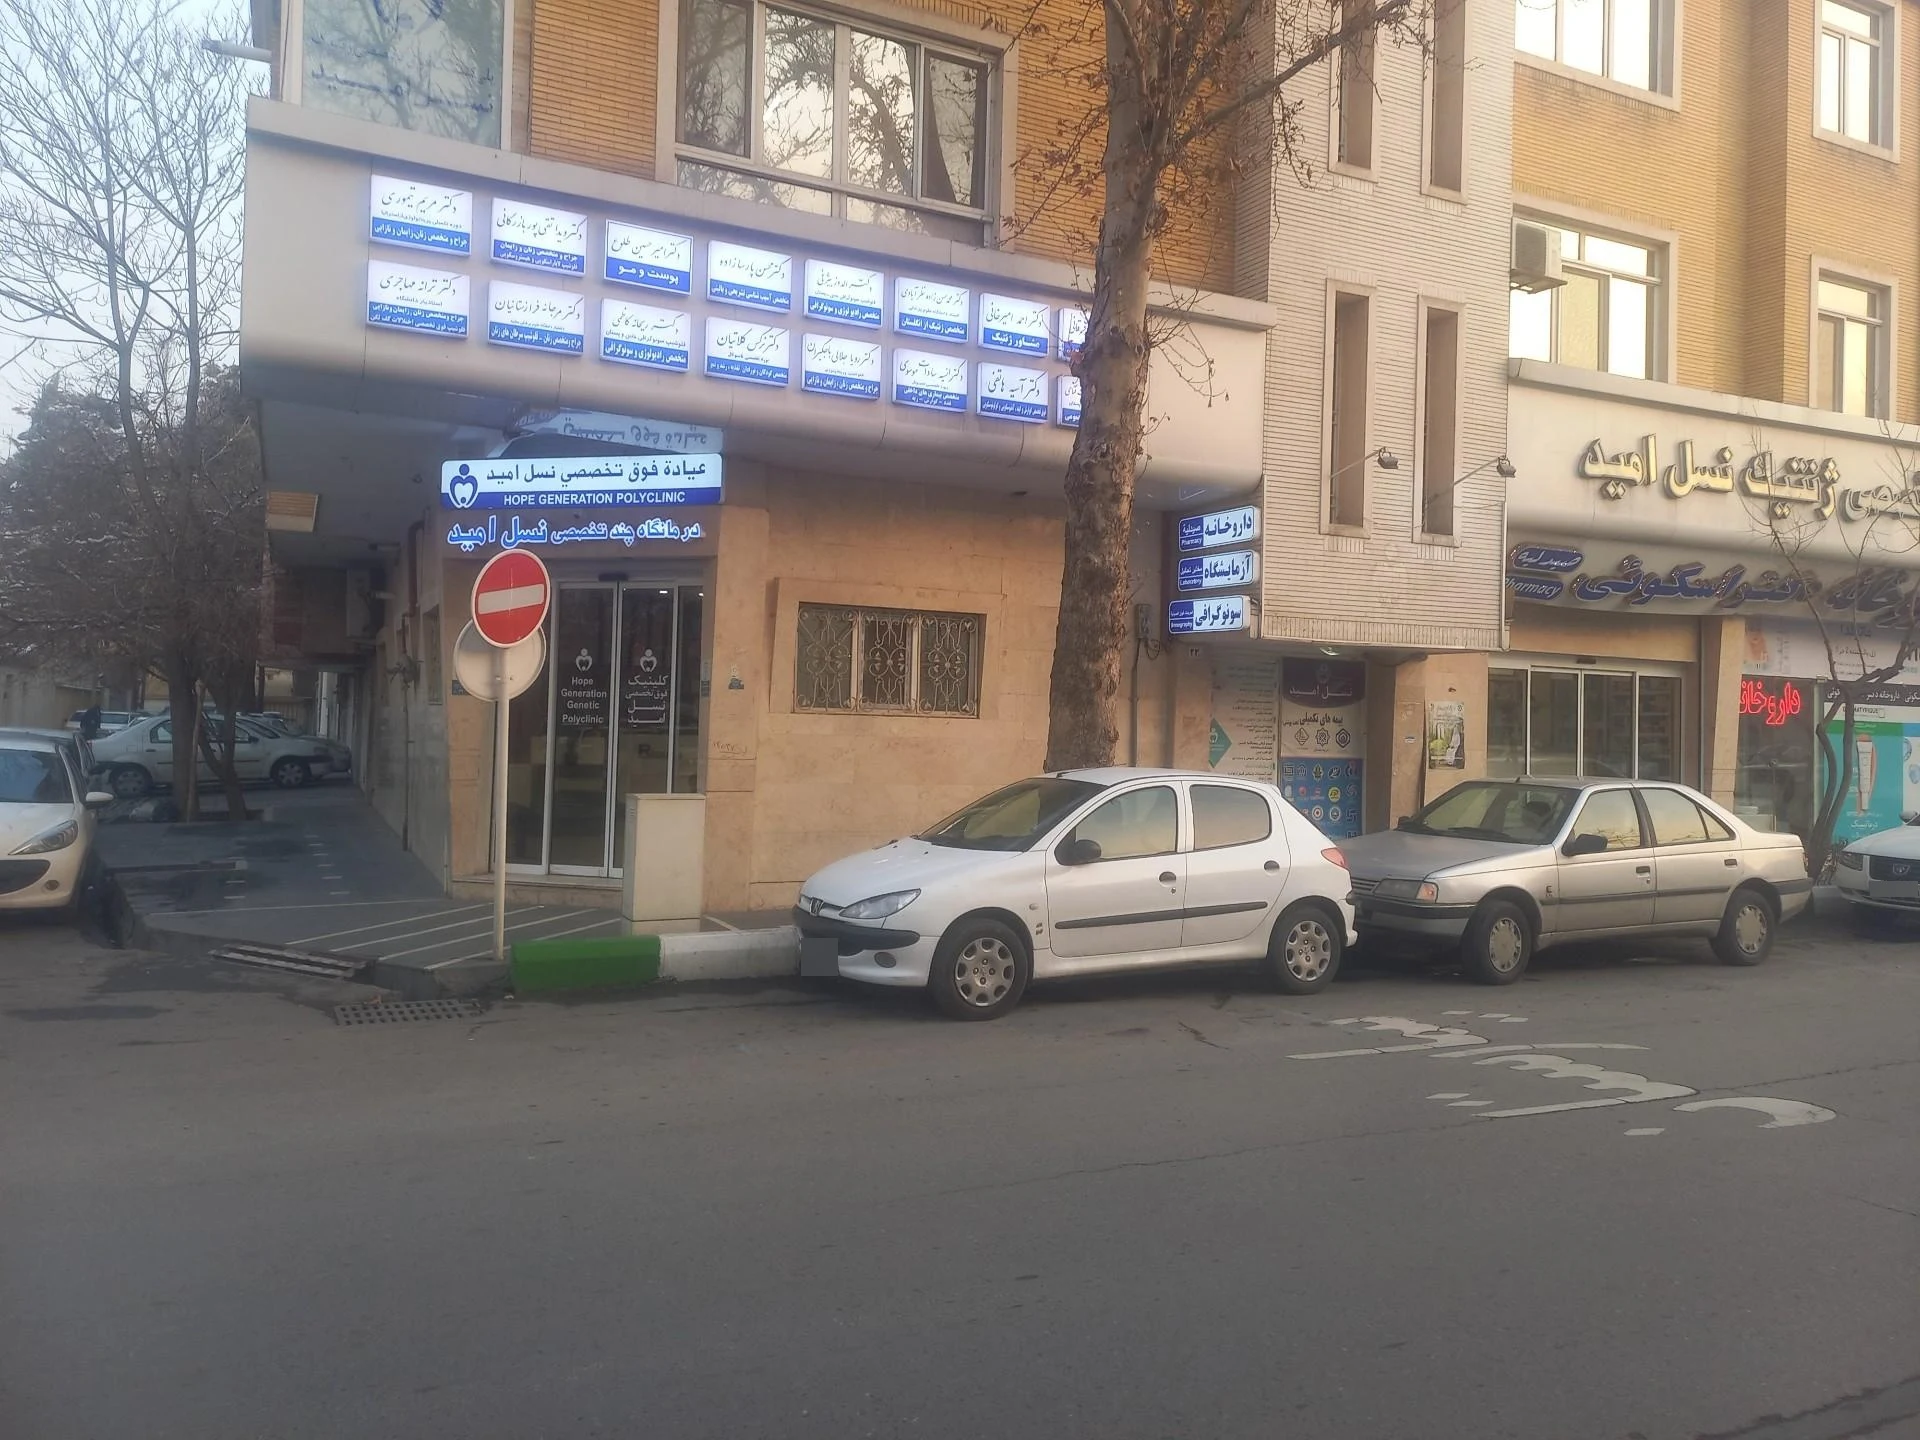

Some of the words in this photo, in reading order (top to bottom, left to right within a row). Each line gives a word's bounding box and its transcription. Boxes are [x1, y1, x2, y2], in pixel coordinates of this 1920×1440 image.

[382, 186, 415, 207] تیموری
[438, 192, 464, 213] دکتر
[416, 197, 436, 213] مریم
[564, 216, 587, 240] دکتر
[428, 233, 449, 241] متخصص
[457, 237, 467, 247] جراح
[537, 249, 558, 258] متخصص
[665, 240, 687, 259] دکتر
[618, 265, 636, 274] مو
[639, 269, 644, 278] و
[768, 257, 792, 279] دکتر
[380, 276, 415, 291] مهاجری
[648, 270, 679, 285] پوست
[418, 279, 437, 292] ترانه
[438, 276, 462, 295] دکتر
[952, 290, 968, 305] دکتر
[542, 300, 561, 319] مرجانه
[562, 297, 583, 320] دکتر
[651, 313, 684, 334] دکتر
[902, 318, 922, 326] انگلستان
[924, 320, 928, 330] از
[1027, 307, 1048, 328] دکتر
[491, 325, 500, 337] زنان
[929, 322, 943, 333] ژنتیک
[945, 326, 964, 334] متخصص
[544, 334, 552, 344] زنان
[571, 340, 581, 349] جراح
[763, 329, 788, 353] دکتر
[992, 333, 1012, 345] ژنتیک
[1016, 338, 1041, 348] مشاور
[605, 342, 633, 357] سونوگرافی
[639, 348, 665, 363] رادیولوژی
[859, 346, 879, 366] دکتر
[666, 354, 686, 363] متخصص
[949, 360, 966, 382] دکتر
[849, 382, 864, 390] متخصص
[868, 383, 878, 393] جراح
[1023, 371, 1048, 400] دکتر
[523, 465, 556, 483] نسل
[628, 463, 659, 483] فوق
[1579, 433, 1658, 500] امید
[1663, 439, 1735, 500] نسل
[1739, 451, 1842, 521] ژنتیک
[503, 494, 536, 506] HOPE
[538, 493, 613, 505] GENERATION
[616, 492, 686, 504] POLYCLINIC
[637, 519, 701, 541] درمانگاه
[1205, 512, 1252, 537] داروخانه
[448, 514, 497, 552] امید
[501, 516, 548, 549] نسل
[551, 521, 608, 544] تخصصی
[610, 525, 635, 547] چند
[1204, 553, 1251, 581] آزمایشگاه
[1195, 603, 1241, 627] سونوگرافی
[571, 676, 594, 686] Hope
[628, 674, 669, 688] کلینیک
[561, 688, 607, 698] Generation
[625, 688, 653, 699] تخصصی
[653, 689, 668, 699] فوق
[567, 701, 600, 709] Genetic
[628, 701, 666, 713] نسل
[562, 714, 604, 725] Polyclinic
[628, 712, 666, 728] امید
